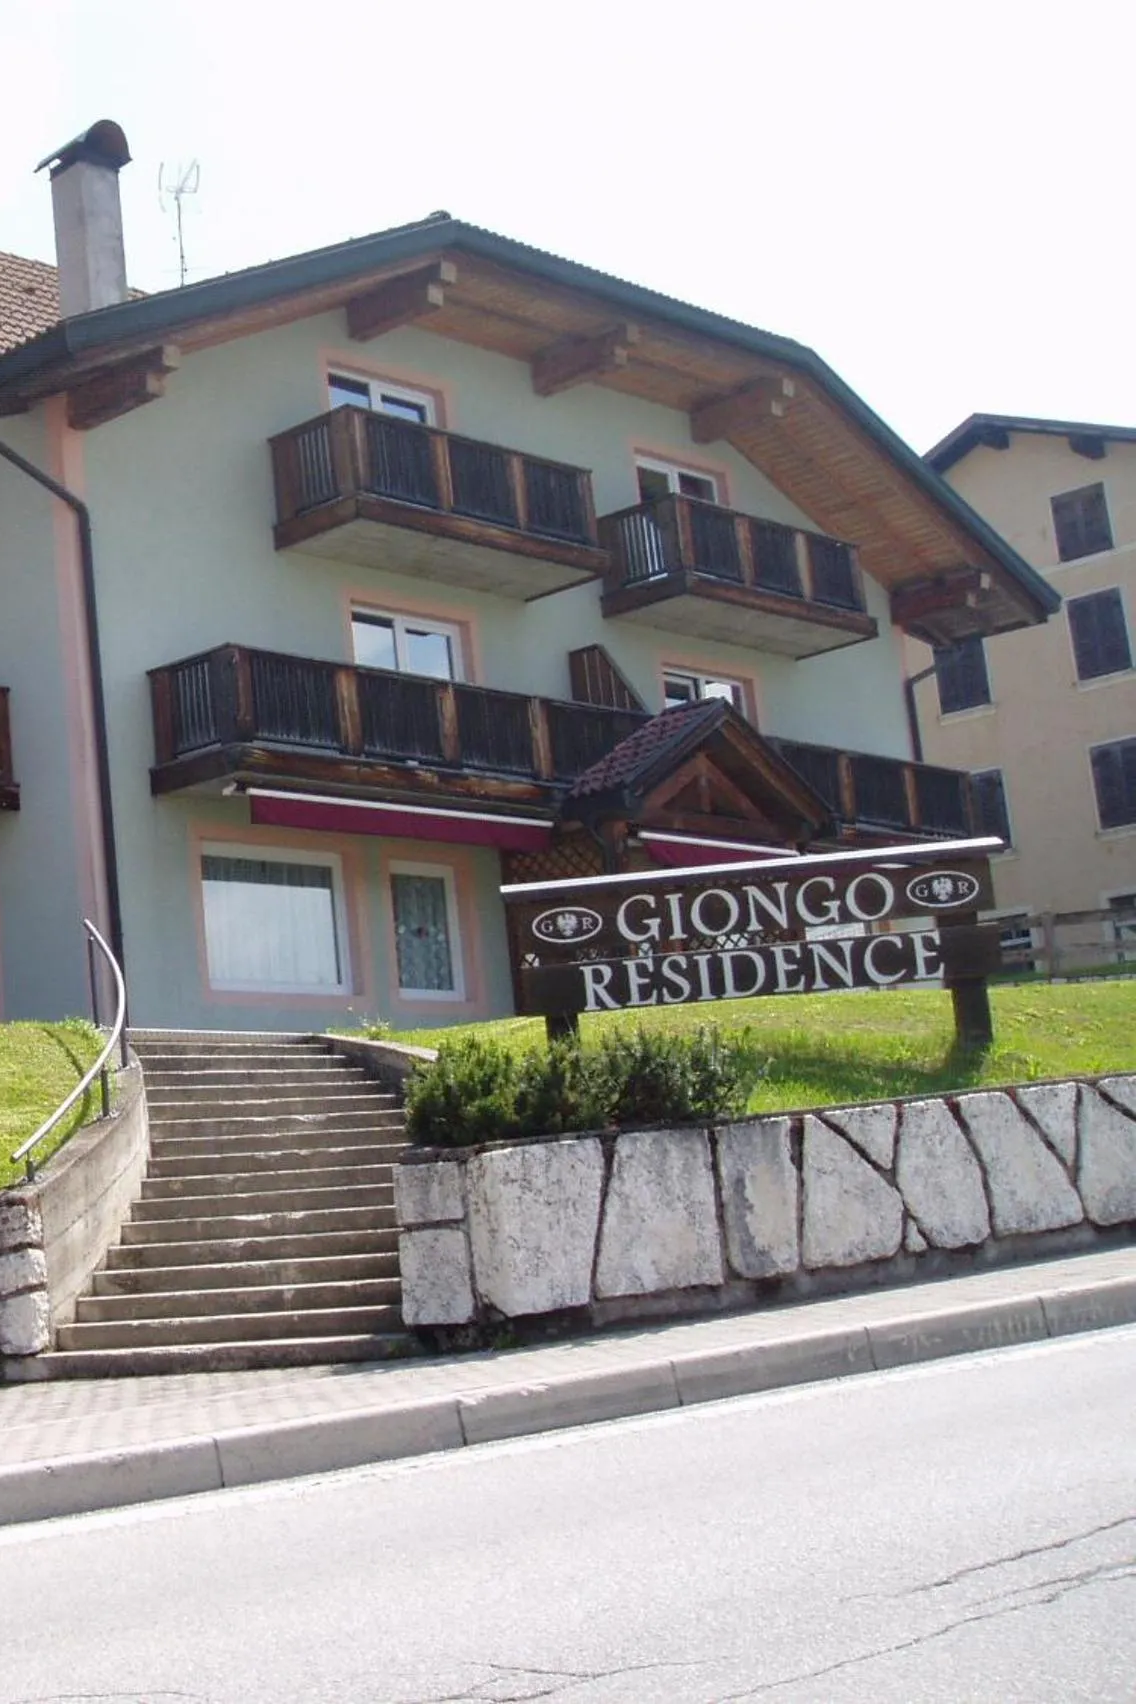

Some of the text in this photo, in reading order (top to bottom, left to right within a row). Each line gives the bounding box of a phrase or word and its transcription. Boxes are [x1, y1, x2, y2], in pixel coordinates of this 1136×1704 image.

[617, 873, 894, 943] GIONGO
[915, 881, 971, 898] G R
[541, 917, 594, 933] G R
[580, 930, 945, 1011] RESIDENCE
